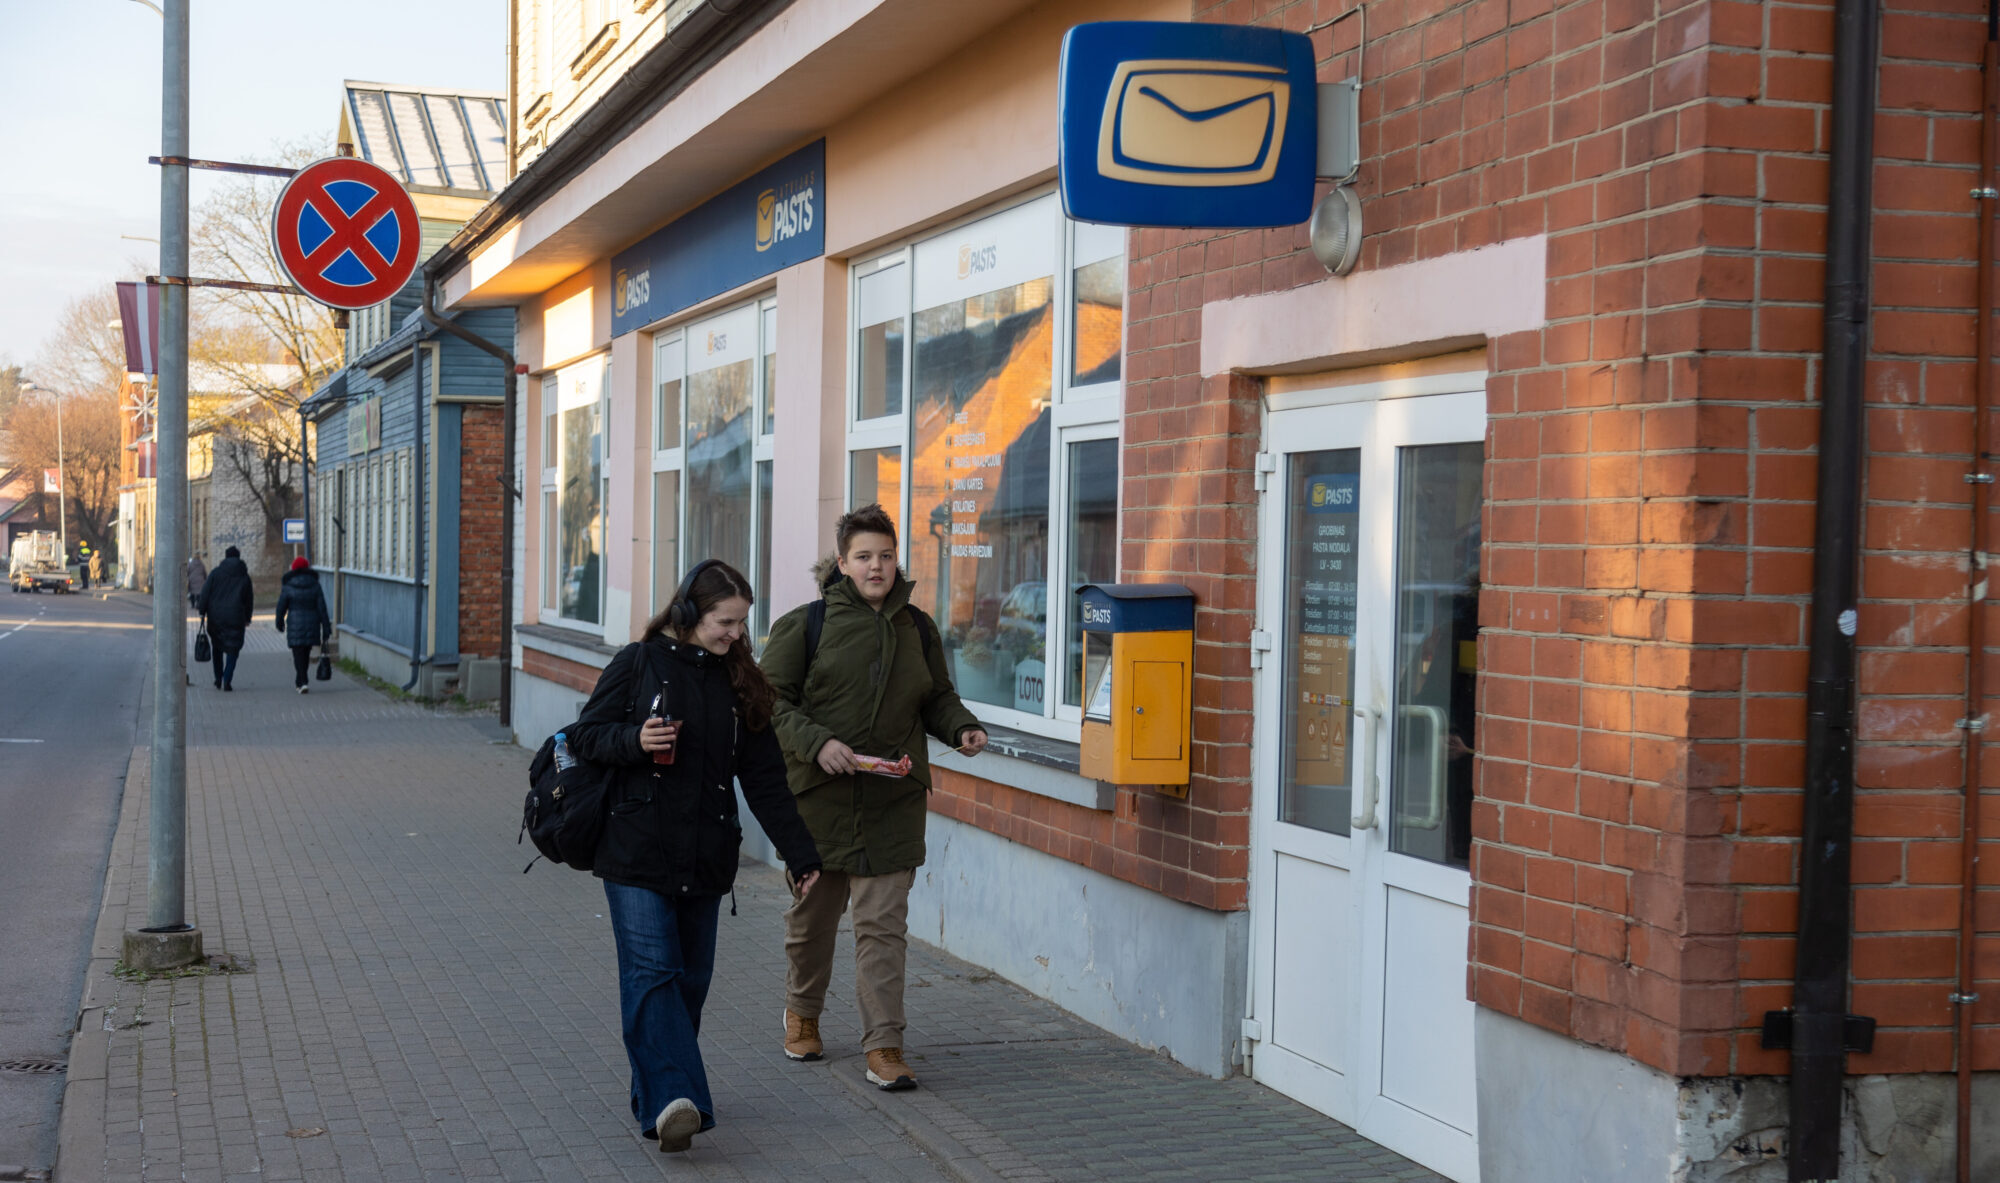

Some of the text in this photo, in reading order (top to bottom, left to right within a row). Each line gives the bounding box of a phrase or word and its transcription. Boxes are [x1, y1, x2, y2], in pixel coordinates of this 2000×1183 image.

[773, 187, 813, 243] PASTS
[970, 244, 997, 275] PASTS
[626, 269, 650, 311] PASTS
[1325, 487, 1353, 505] PASTS
[1312, 542, 1328, 553] PASTA
[1092, 609, 1111, 623] PASTS
[1019, 674, 1044, 704] LOTO
